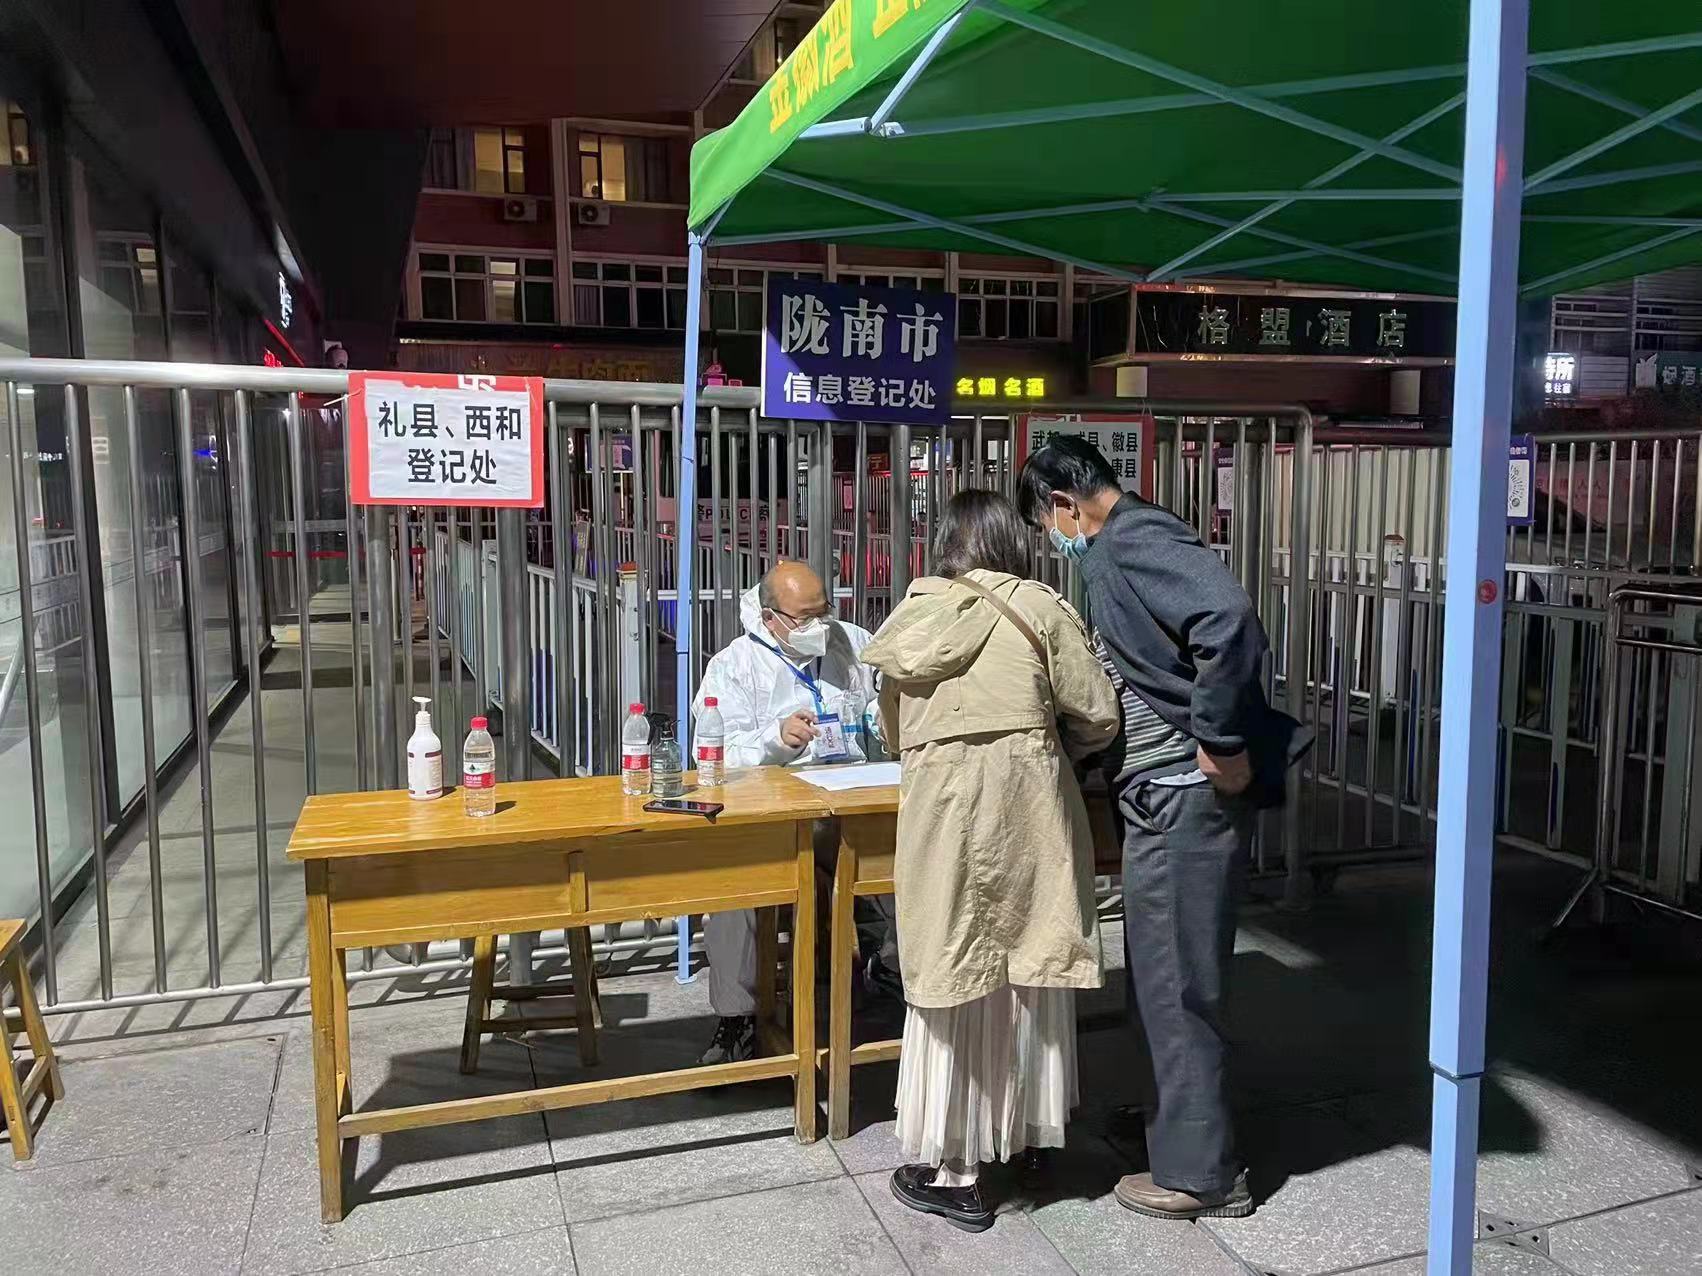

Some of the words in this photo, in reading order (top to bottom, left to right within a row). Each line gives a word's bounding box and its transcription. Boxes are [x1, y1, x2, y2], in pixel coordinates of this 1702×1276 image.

[780, 293, 944, 363] 陇南市
[1198, 304, 1408, 348] 格盟酒店
[783, 371, 937, 410] 信息登记处
[956, 377, 1044, 397] 名烟名酒
[377, 400, 522, 441] 礼县、西和
[407, 447, 498, 485] 登记处
